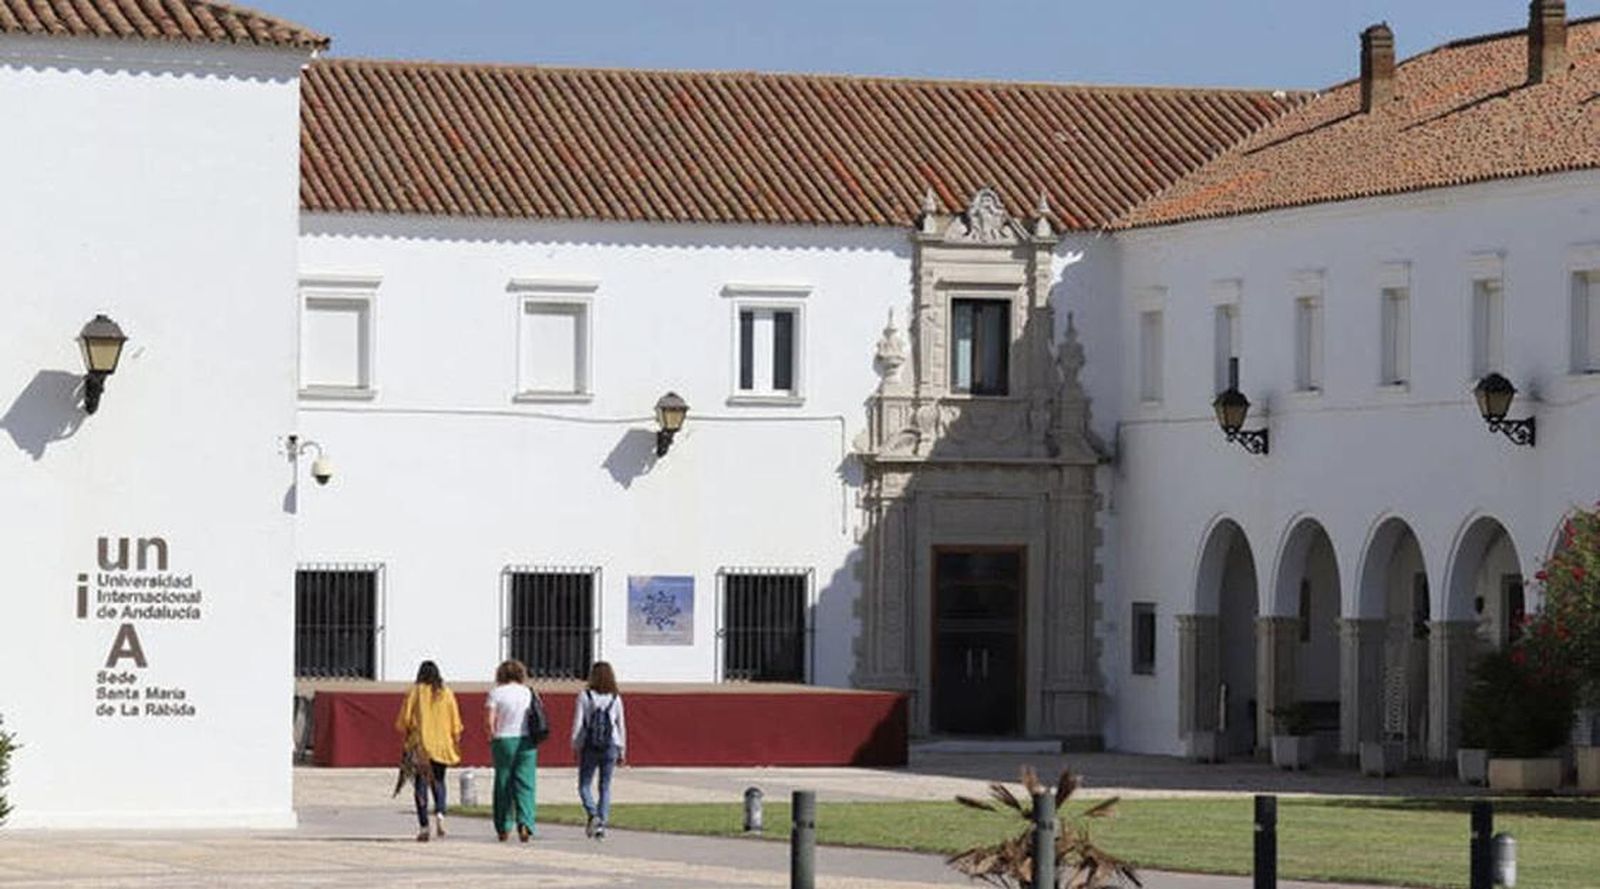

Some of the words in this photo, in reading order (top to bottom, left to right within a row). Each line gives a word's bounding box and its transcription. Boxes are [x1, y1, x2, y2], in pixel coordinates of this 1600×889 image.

[97, 537, 168, 571] un
[97, 574, 193, 588] Universidad
[97, 589, 202, 604] Internacional
[96, 606, 118, 619] de
[121, 605, 201, 620] Andalucía
[105, 623, 148, 668] A
[96, 670, 137, 685] Sede
[96, 687, 140, 700] Santa
[96, 703, 116, 717] de
[120, 703, 140, 717] La
